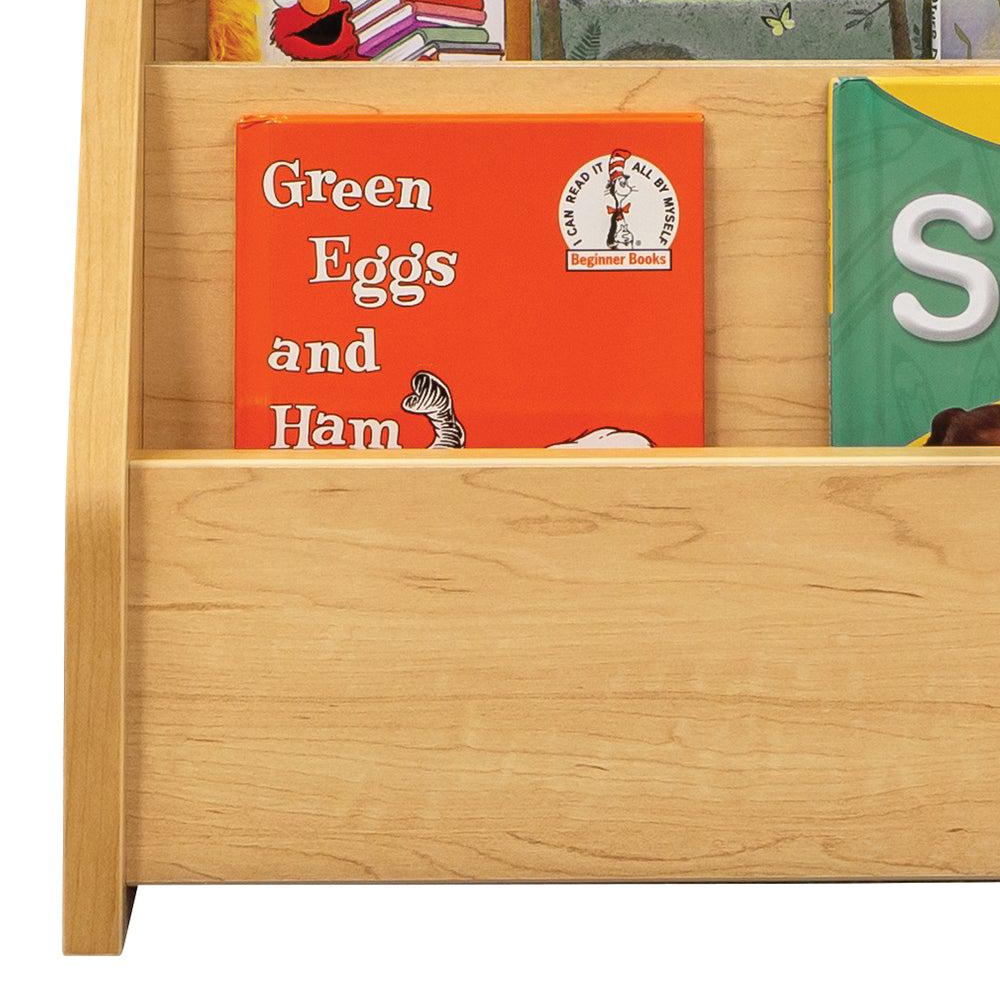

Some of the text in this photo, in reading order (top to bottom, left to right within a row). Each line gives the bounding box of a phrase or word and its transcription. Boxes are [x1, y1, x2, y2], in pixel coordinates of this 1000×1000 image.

[262, 158, 432, 211] Green
[565, 172, 590, 203] READ
[592, 162, 603, 174] IT
[564, 210, 578, 236] CAN
[632, 162, 675, 246] ALL BY MYSELF
[308, 235, 458, 308] Eggs
[571, 253, 666, 268] Beginner Books
[267, 328, 381, 373] and
[269, 404, 402, 449] Ham
